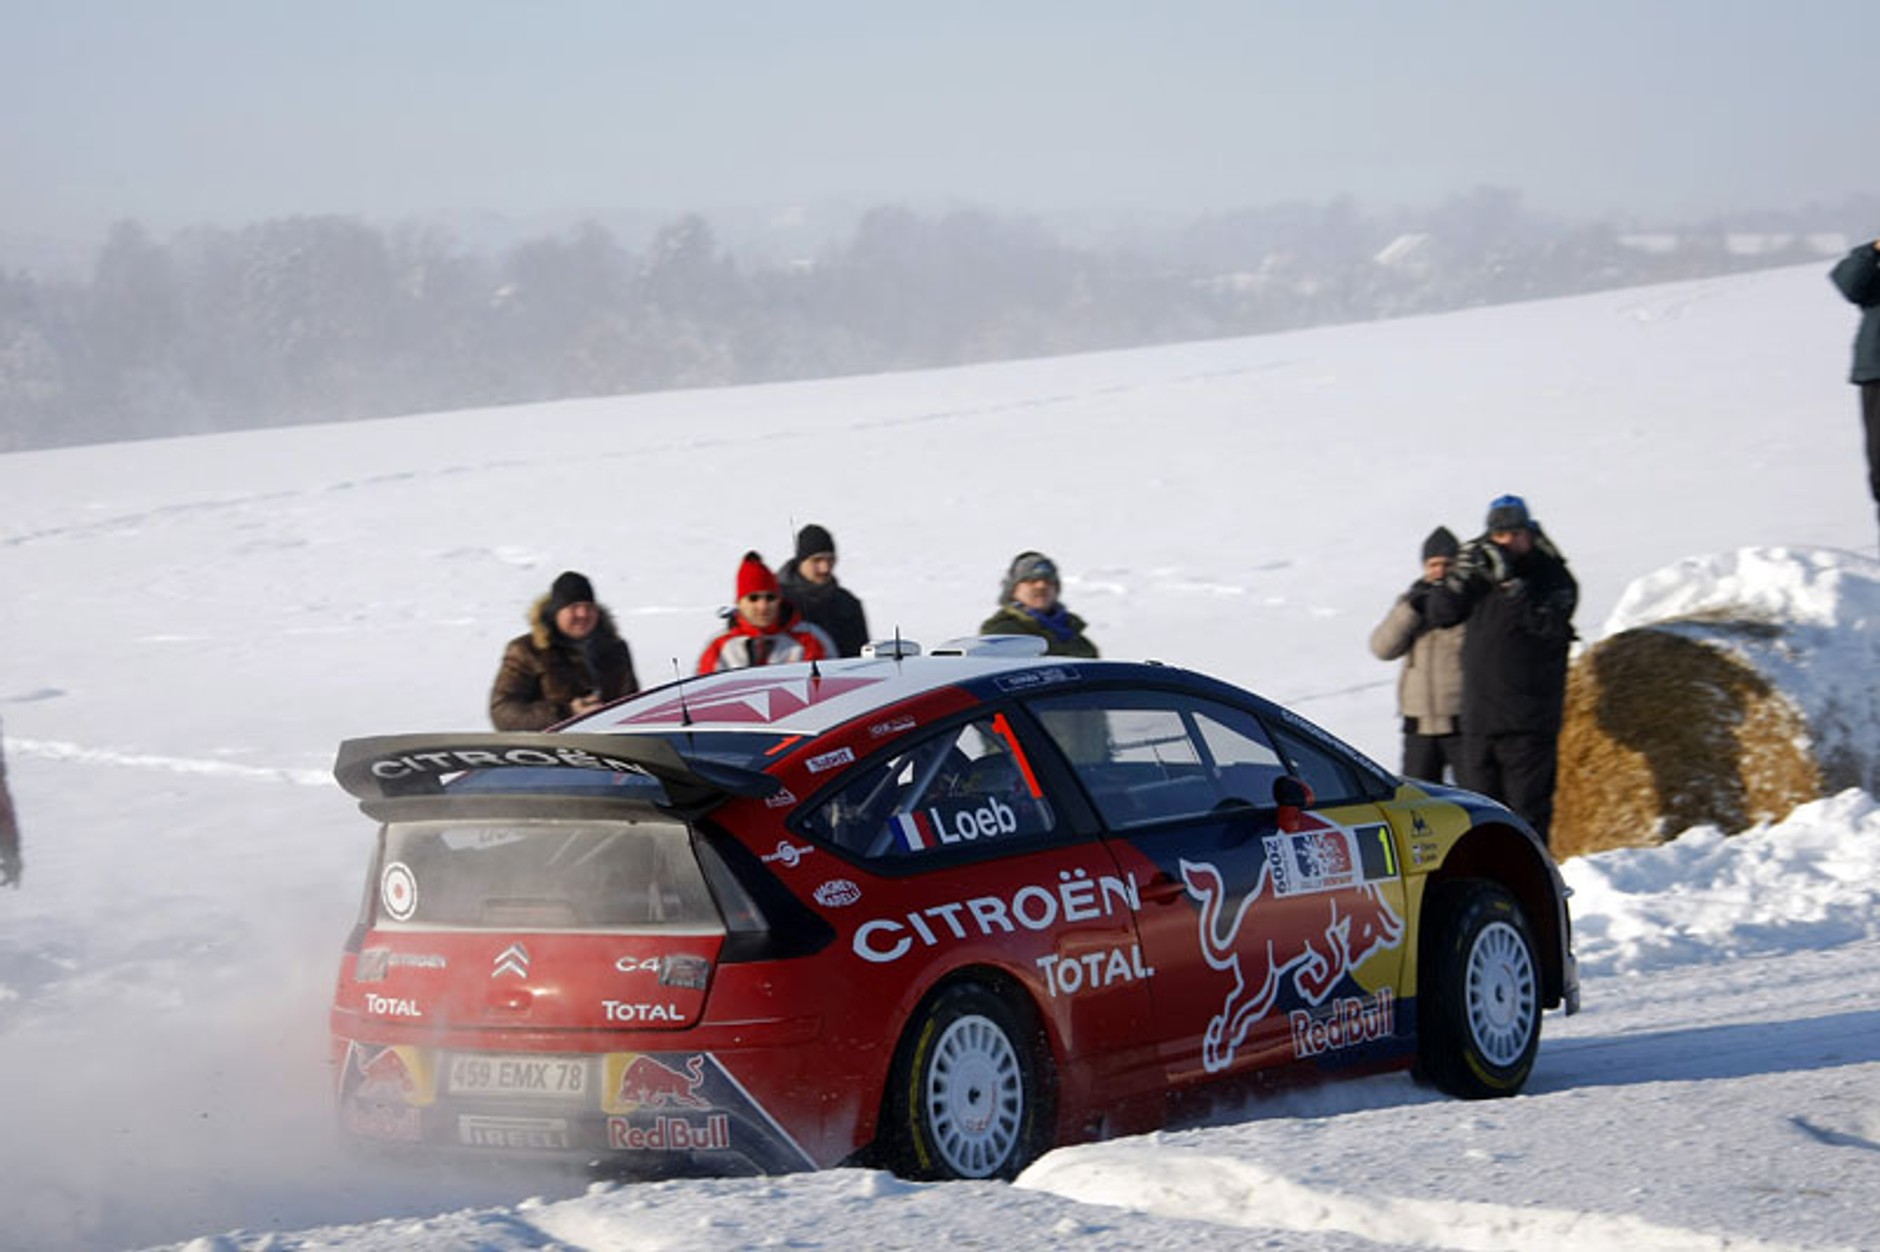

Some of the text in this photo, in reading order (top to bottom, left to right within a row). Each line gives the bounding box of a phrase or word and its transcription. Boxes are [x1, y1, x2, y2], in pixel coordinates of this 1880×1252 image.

[930, 796, 1017, 846] Loeb
[1265, 840, 1287, 894] 2009
[1378, 827, 1394, 875] 1
[852, 868, 1142, 963] CITROËN
[614, 955, 661, 973] C4
[1036, 944, 1155, 998] TOTAL
[365, 993, 422, 1018] TOTAL
[602, 1000, 686, 1022] TOTAL
[1292, 988, 1394, 1058] Red Bull
[452, 1055, 583, 1092] 459 EMX 78
[608, 1113, 731, 1151] Red Bull
